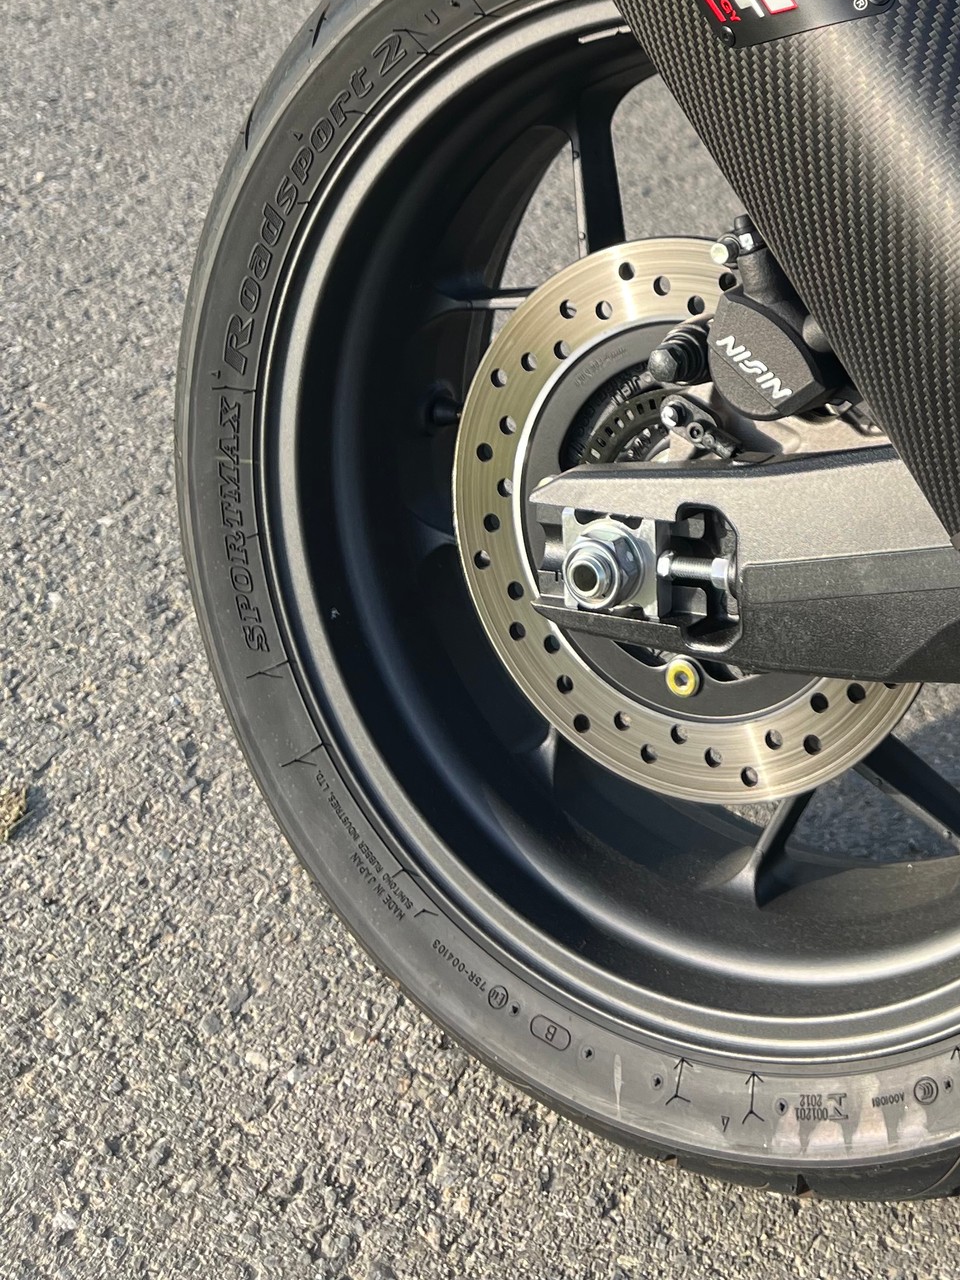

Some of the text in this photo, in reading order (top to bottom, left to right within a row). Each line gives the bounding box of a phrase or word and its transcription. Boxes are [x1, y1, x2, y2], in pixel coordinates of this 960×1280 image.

[223, 32, 409, 375] Roadsport 2
[218, 396, 270, 652] SPORTMAX
[358, 840, 384, 872] RUBBER
[350, 851, 406, 921] MADE IN JAPAN
[432, 938, 487, 992] 75R-004103
[544, 1024, 558, 1042] B
[800, 1094, 822, 1107] 2012
